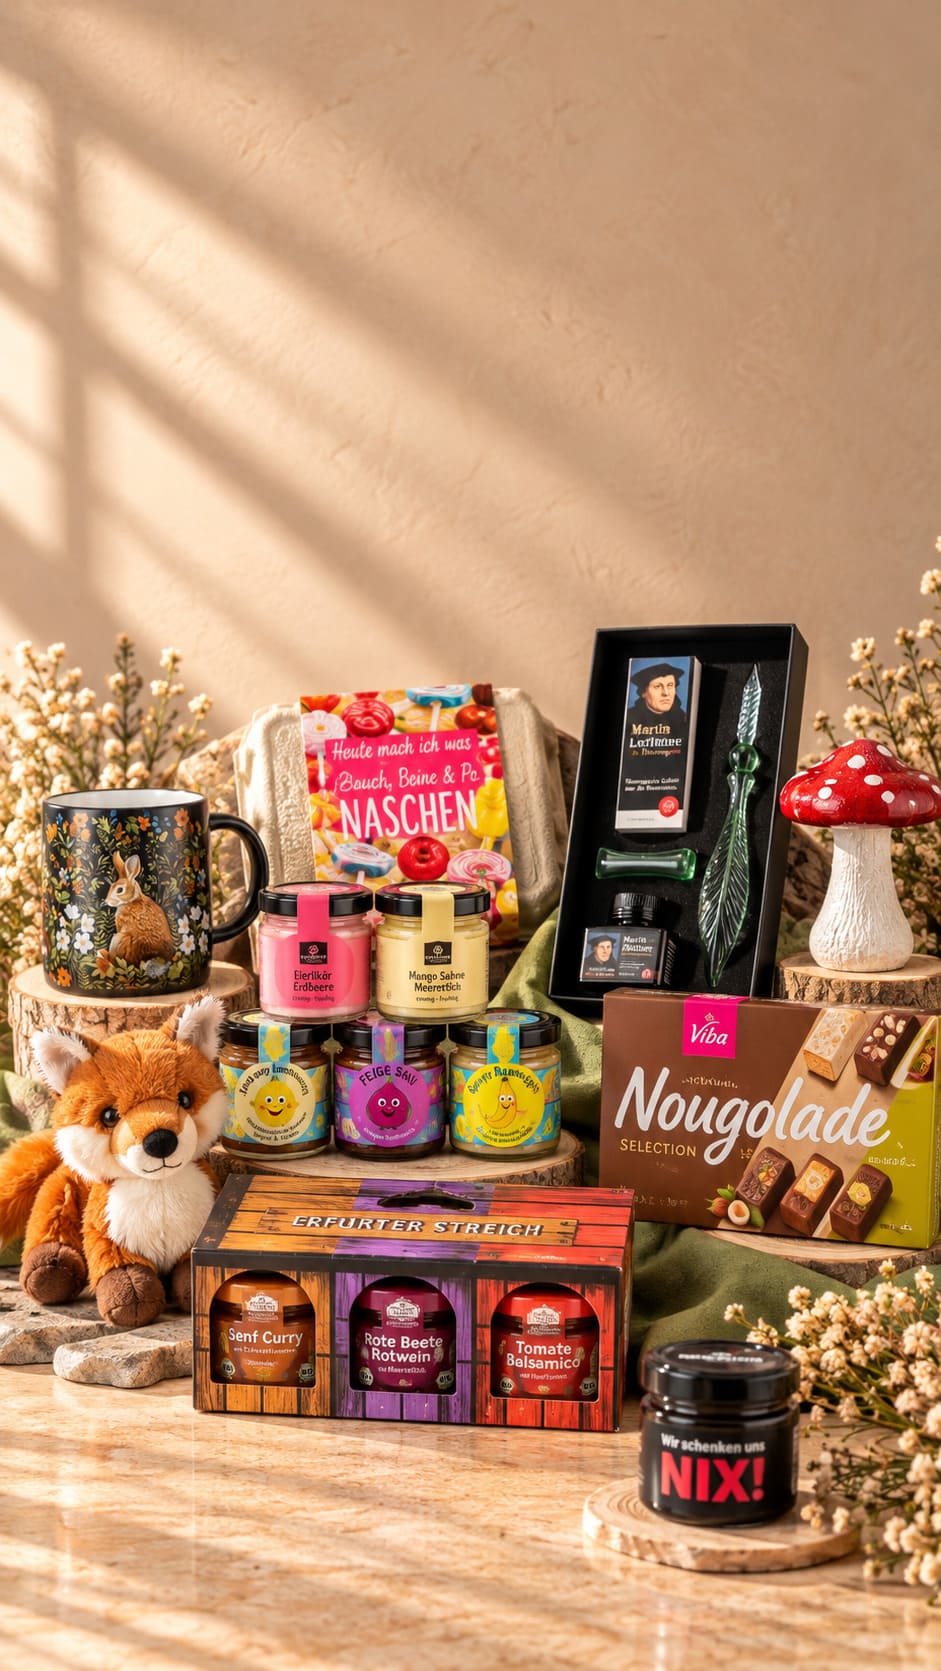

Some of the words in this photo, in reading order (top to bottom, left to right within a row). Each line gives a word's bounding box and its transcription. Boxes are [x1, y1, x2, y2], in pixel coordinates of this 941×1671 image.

[332, 741, 373, 760] Heute
[377, 741, 414, 757] mach
[419, 734, 440, 753] ich
[445, 737, 472, 751] was
[399, 766, 437, 788] Beine
[443, 765, 455, 783] &
[340, 790, 478, 840] NASCHEN
[408, 970, 438, 983] Mango
[691, 1020, 728, 1046] Viba
[359, 1065, 391, 1086] FEIGE
[614, 1066, 891, 1166] Nougolade
[620, 1138, 697, 1158] SELECTION
[292, 1215, 424, 1232] ERFURTER
[434, 1221, 544, 1237] STREICH
[228, 1327, 259, 1343] Senf
[262, 1331, 303, 1347] Curry
[364, 1331, 396, 1348] Rote
[401, 1335, 443, 1349] Beete
[516, 1340, 572, 1355] Tomate
[371, 1347, 431, 1363] Rotwein
[506, 1353, 581, 1369] Balsamico
[661, 1433, 681, 1449] Wir
[681, 1438, 742, 1454] schenken
[745, 1441, 766, 1453] uns
[660, 1450, 766, 1503] NIX!
